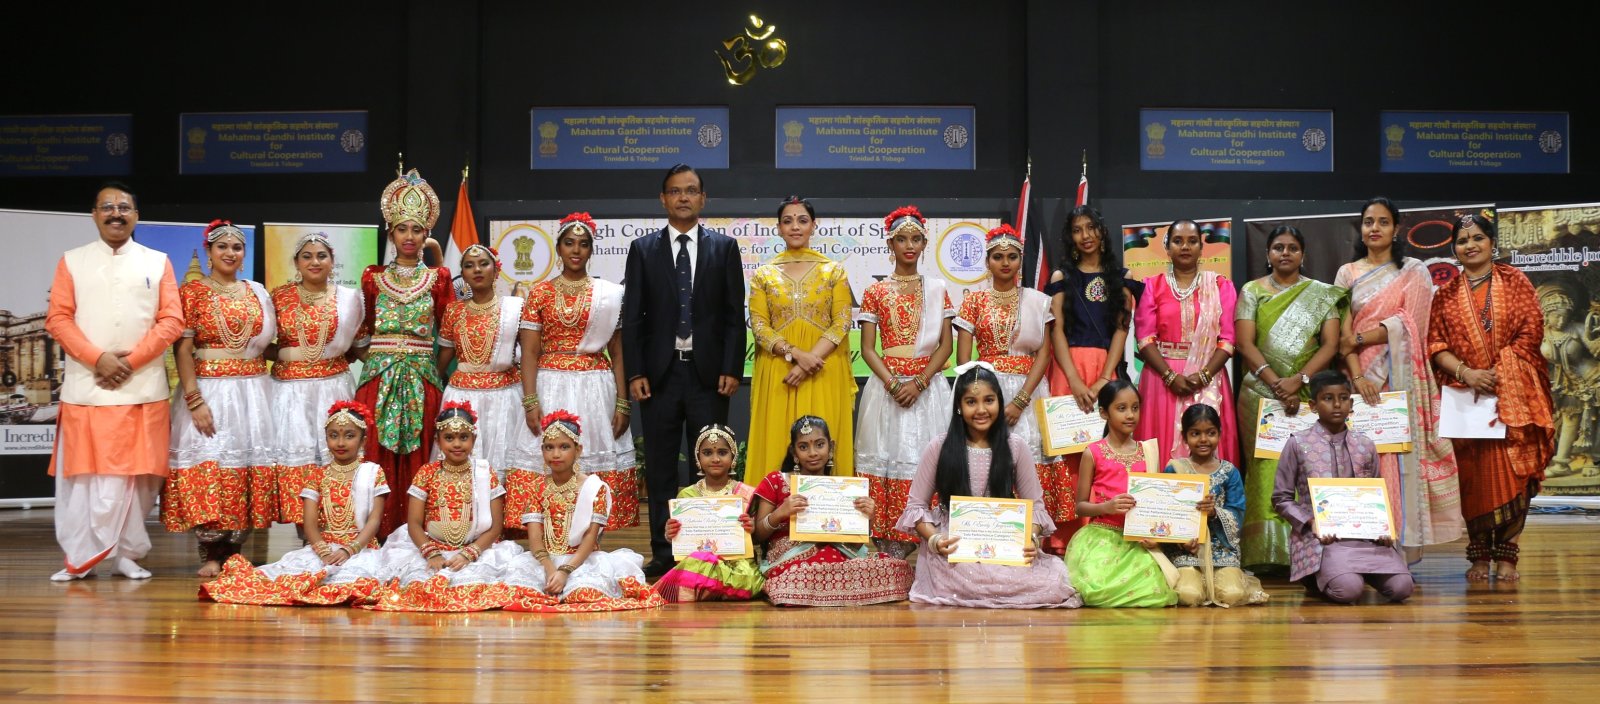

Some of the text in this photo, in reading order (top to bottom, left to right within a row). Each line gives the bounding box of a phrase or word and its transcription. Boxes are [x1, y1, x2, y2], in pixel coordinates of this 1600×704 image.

[571, 127, 692, 136] Mahatma Gandhi Institute
[816, 127, 938, 135] Mahatma Gandhi Institute
[1178, 130, 1297, 138] Mahatma Gandhi Institute
[0, 136, 27, 144] hatma
[63, 136, 101, 144] Institute
[623, 146, 679, 155] Cooperation
[868, 146, 925, 154] Cooperation
[1229, 148, 1285, 157] Cooperation
[1466, 150, 1521, 159] Cooperation
[35, 154, 88, 163] Cooperation
[268, 151, 323, 160] Cooperation
[732, 224, 749, 236] of
[848, 224, 865, 236] of
[752, 244, 769, 253] for
[831, 244, 890, 256] Co-opera
[1510, 247, 1582, 264] Incredible
[5, 428, 54, 442] Incredi
